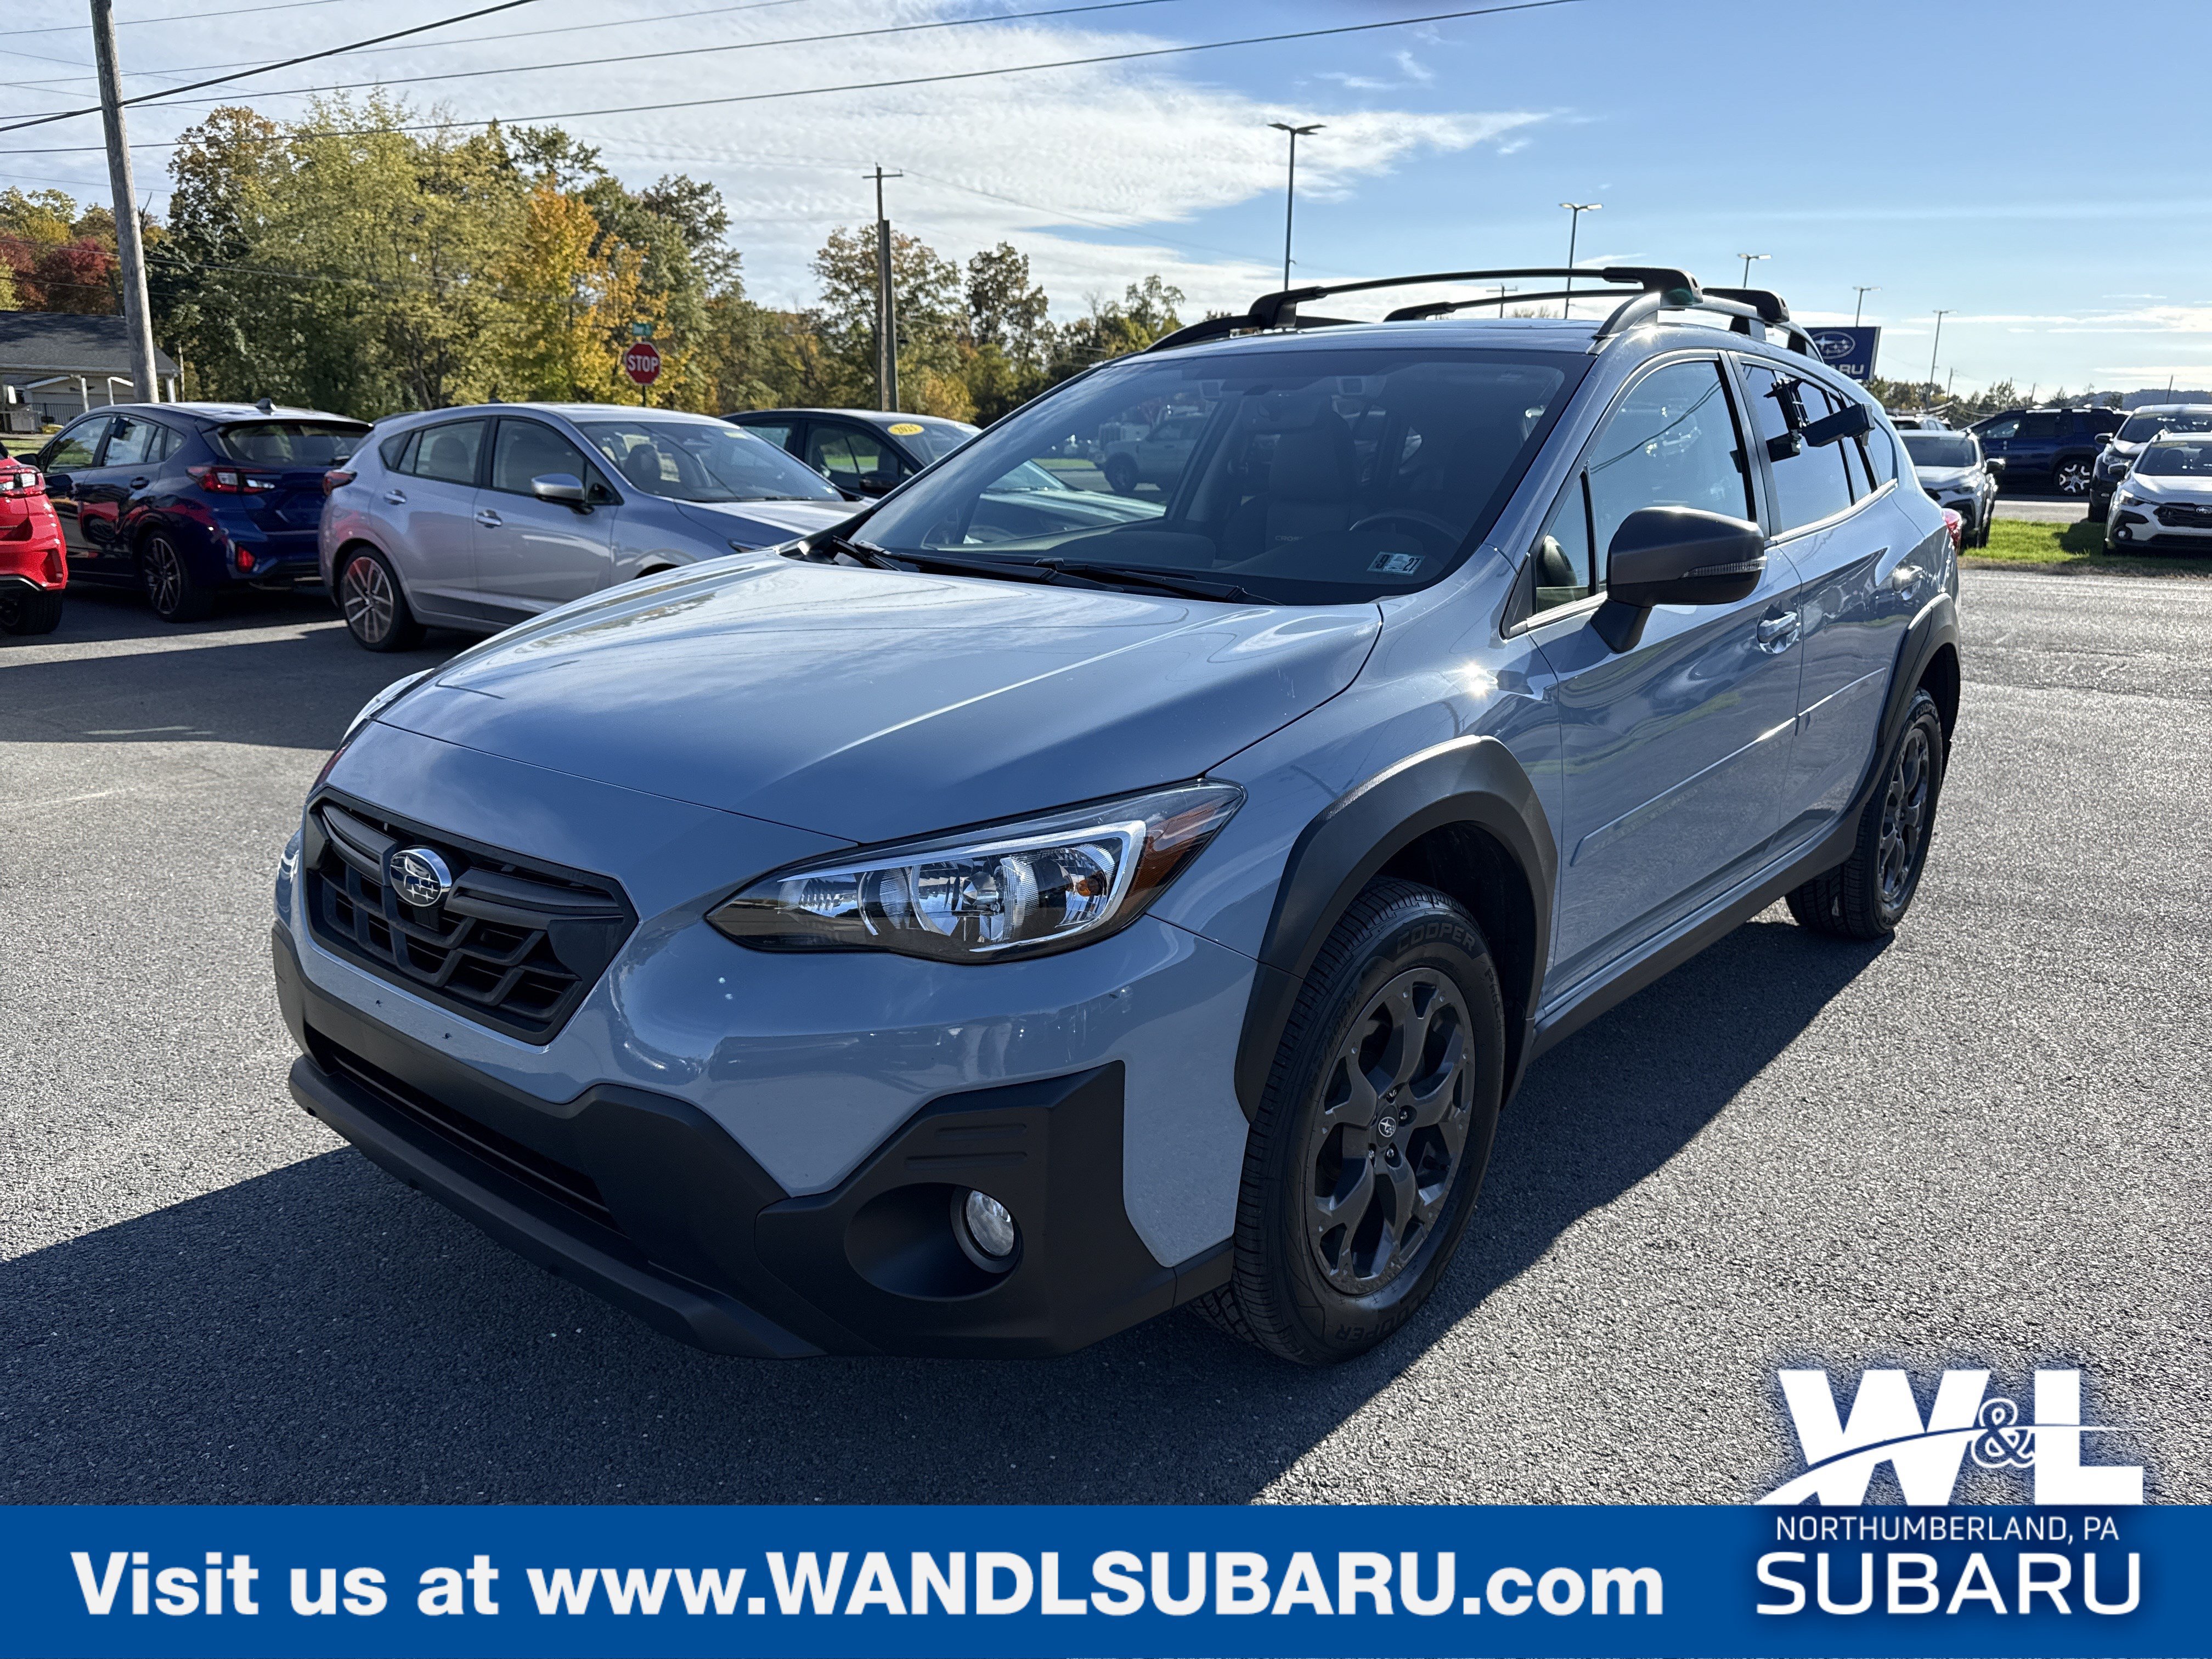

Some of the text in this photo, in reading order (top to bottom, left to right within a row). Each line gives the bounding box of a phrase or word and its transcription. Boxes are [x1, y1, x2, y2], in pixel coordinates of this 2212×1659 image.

[627, 354, 659, 373] STOP
[1402, 557, 1420, 572] 27
[1397, 922, 1475, 955] COOPER
